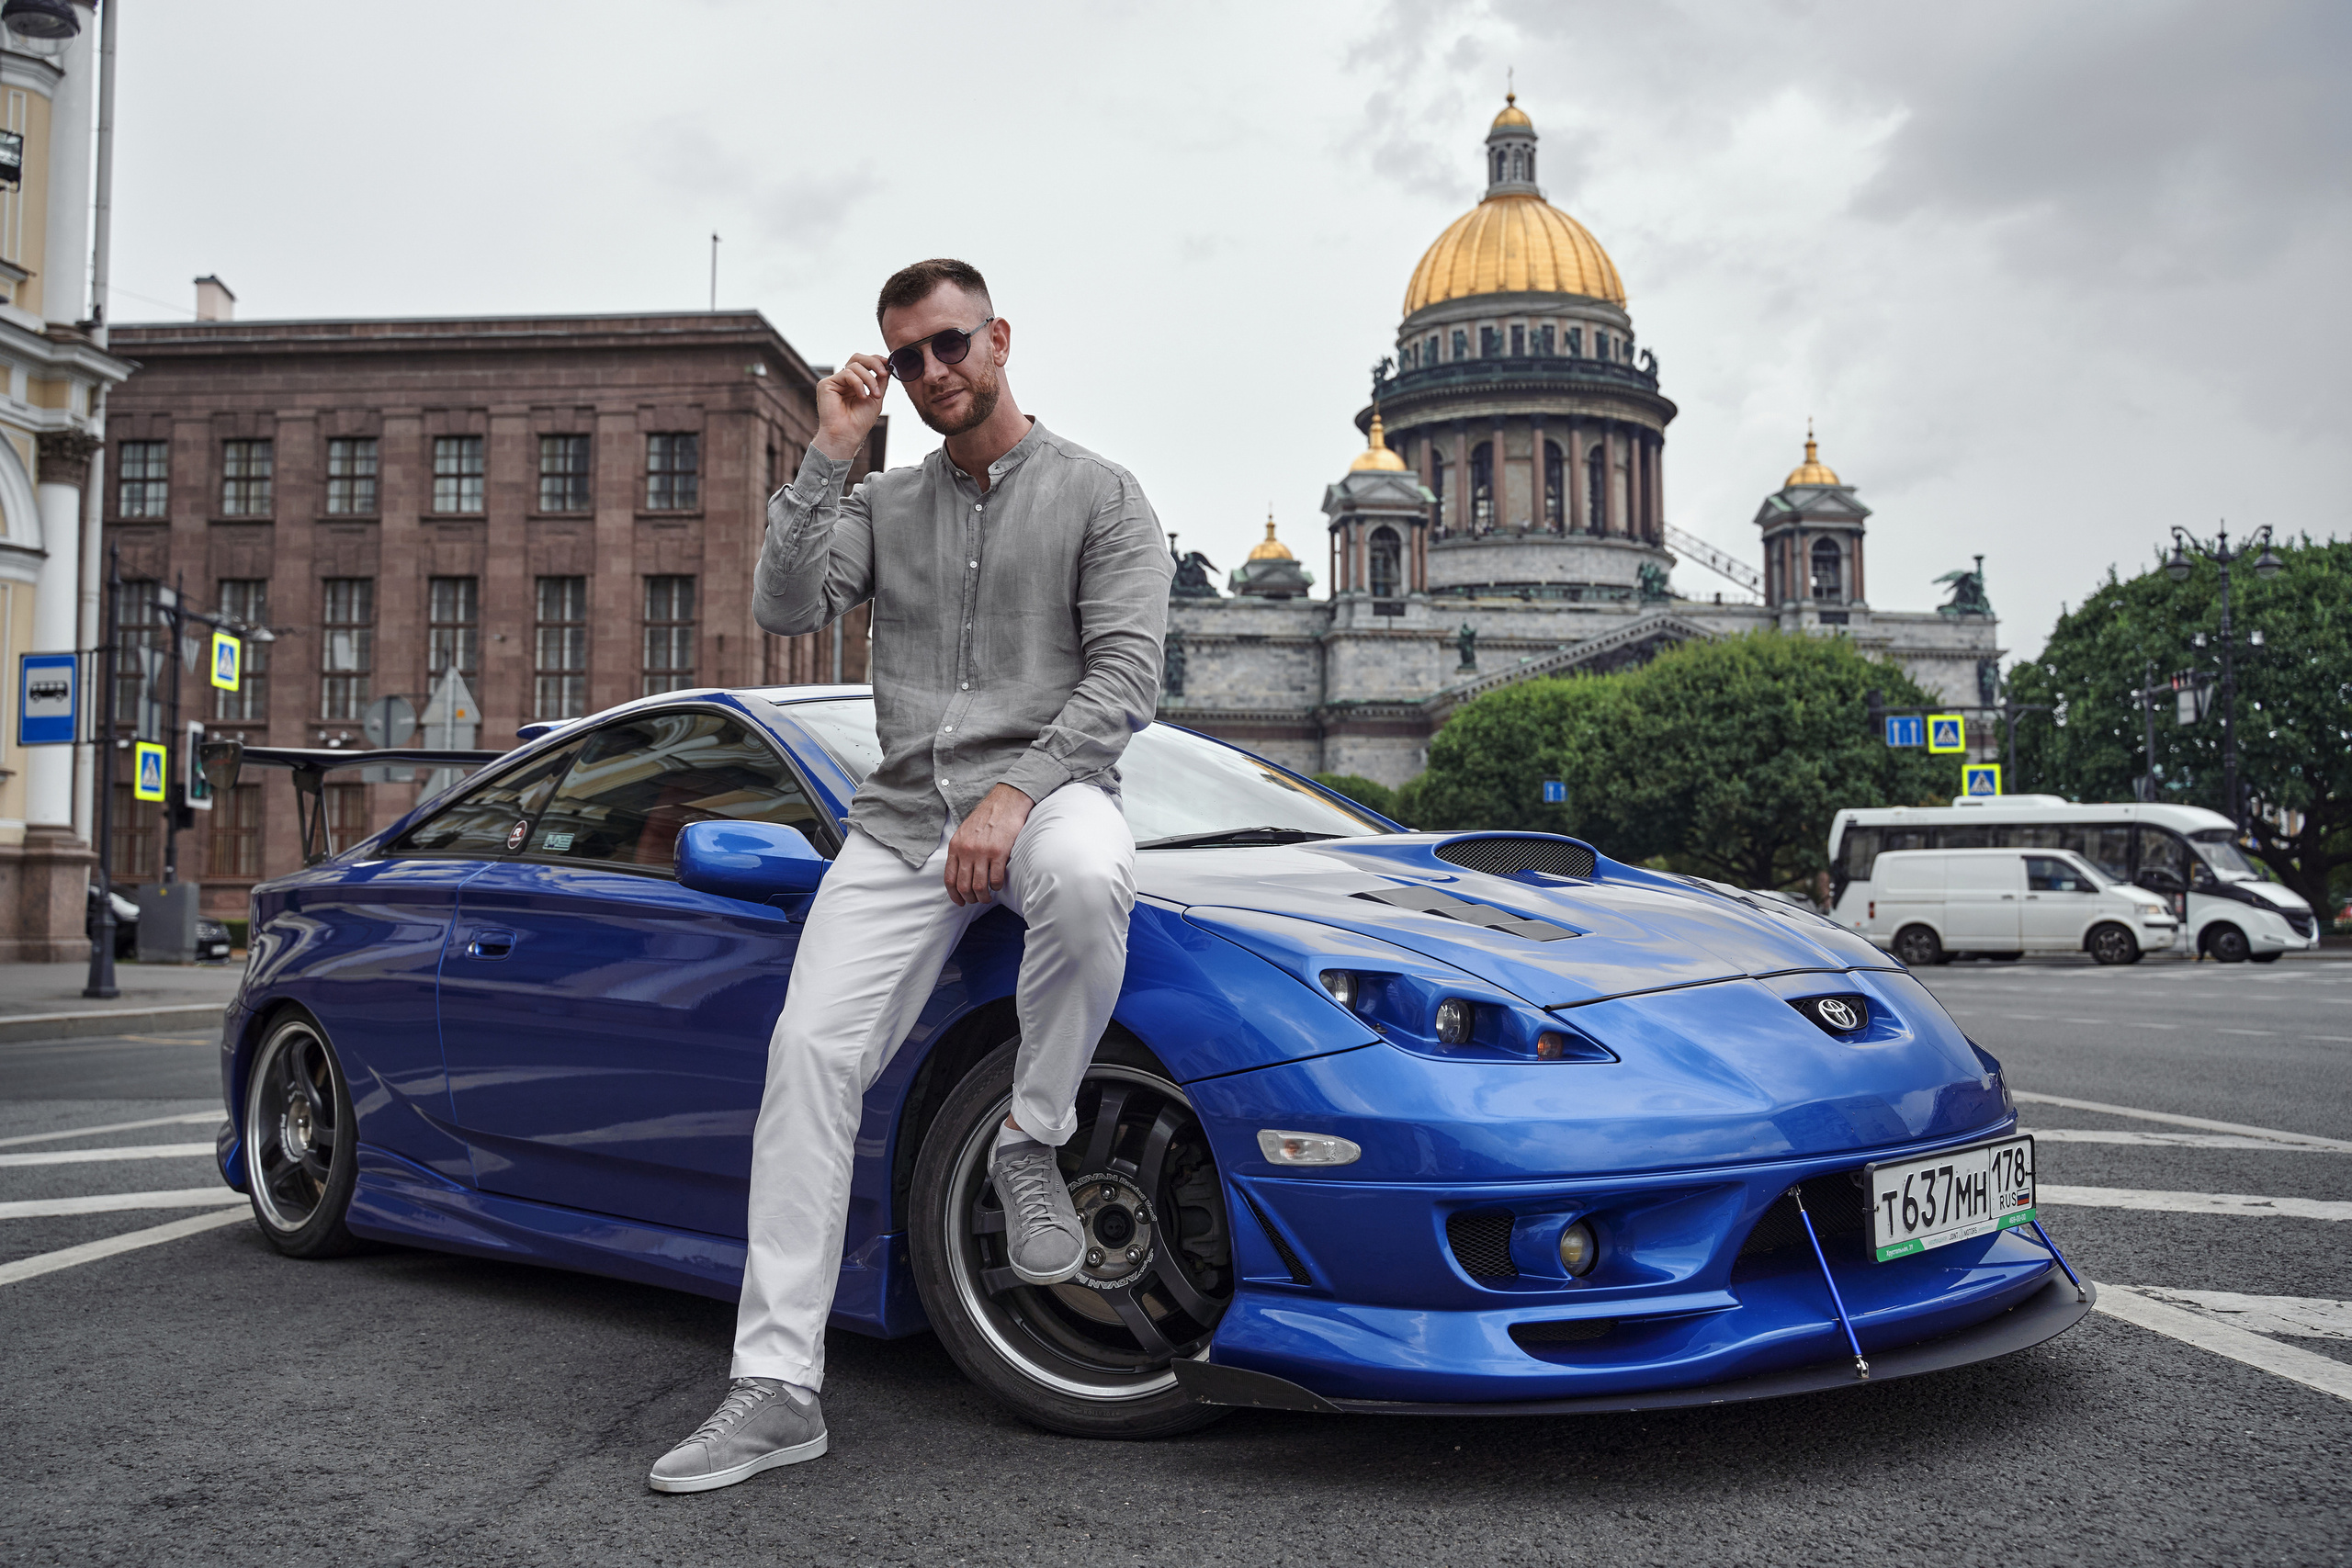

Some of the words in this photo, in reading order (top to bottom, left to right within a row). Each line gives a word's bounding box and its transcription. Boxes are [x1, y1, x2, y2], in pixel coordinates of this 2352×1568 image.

[1882, 1165, 1987, 1237] Т637МН
[1991, 1146, 2025, 1193] 178
[1999, 1192, 2017, 1211] RUS
[1088, 1271, 1138, 1290] ADVAN
